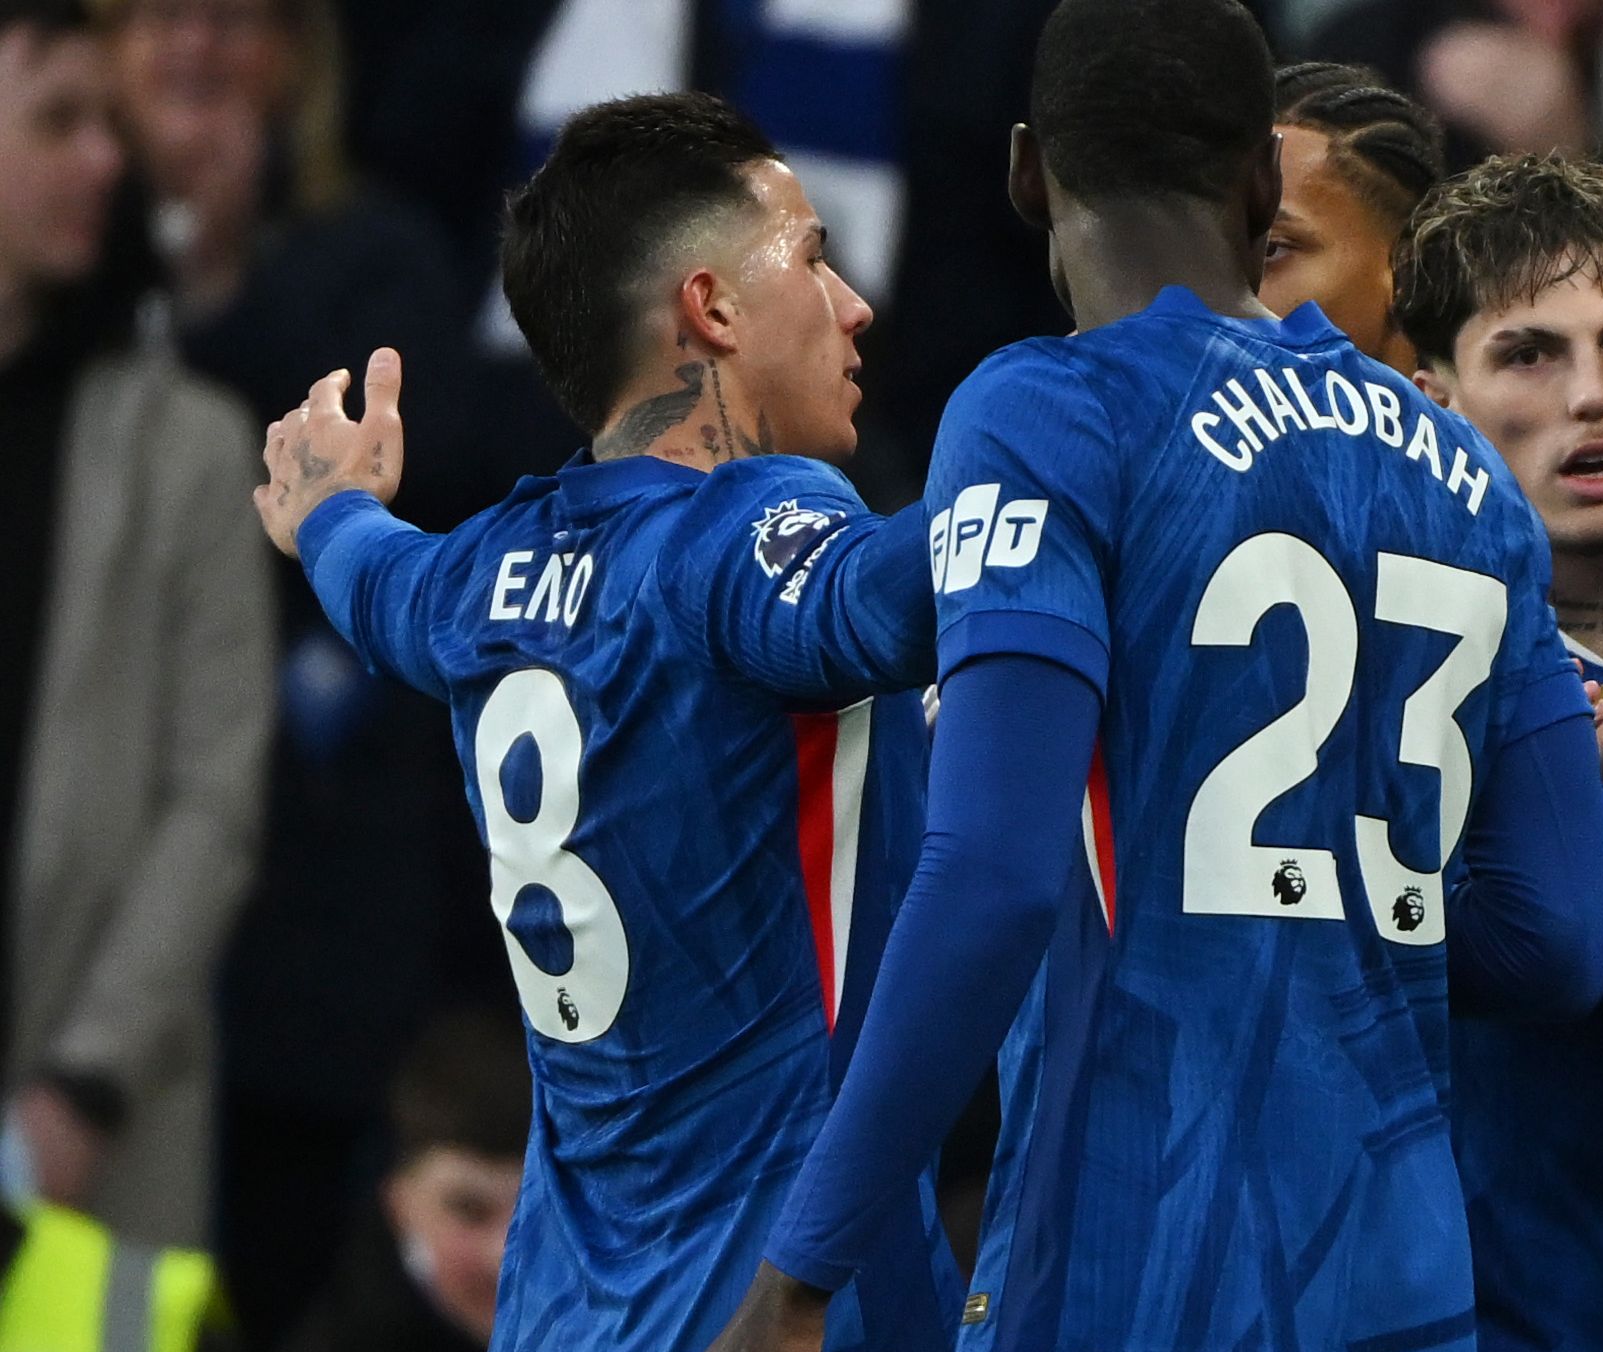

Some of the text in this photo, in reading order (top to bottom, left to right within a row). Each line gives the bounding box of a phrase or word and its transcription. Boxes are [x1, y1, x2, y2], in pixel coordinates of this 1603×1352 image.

[1190, 367, 1490, 517] CHALOBAH
[489, 551, 593, 628] ENO
[931, 499, 1043, 583] FPT
[1182, 532, 1508, 946] 23
[474, 668, 630, 1043] 8
